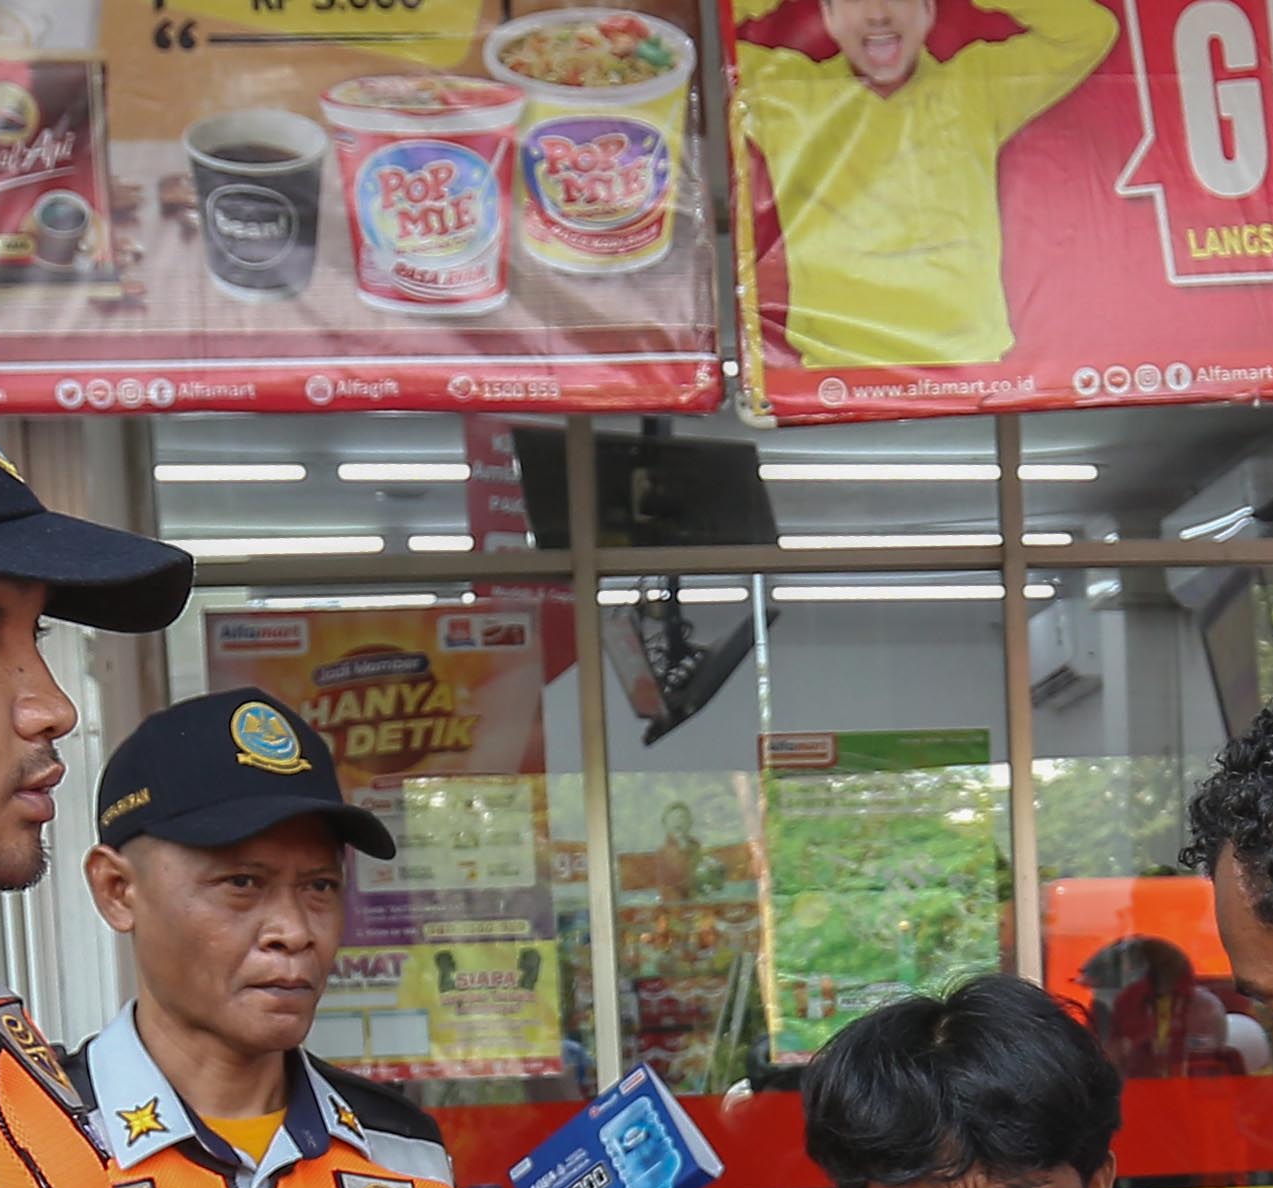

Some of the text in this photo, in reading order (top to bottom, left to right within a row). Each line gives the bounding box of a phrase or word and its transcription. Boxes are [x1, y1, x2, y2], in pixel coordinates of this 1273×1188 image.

[536, 134, 630, 175] POP
[377, 160, 456, 208] POP
[178, 381, 256, 401] Alfamart
[335, 379, 400, 402] Alfagift
[852, 376, 1034, 398] www.alfamart.co.id
[299, 681, 456, 727] HANYA
[345, 714, 481, 758] DETIK
